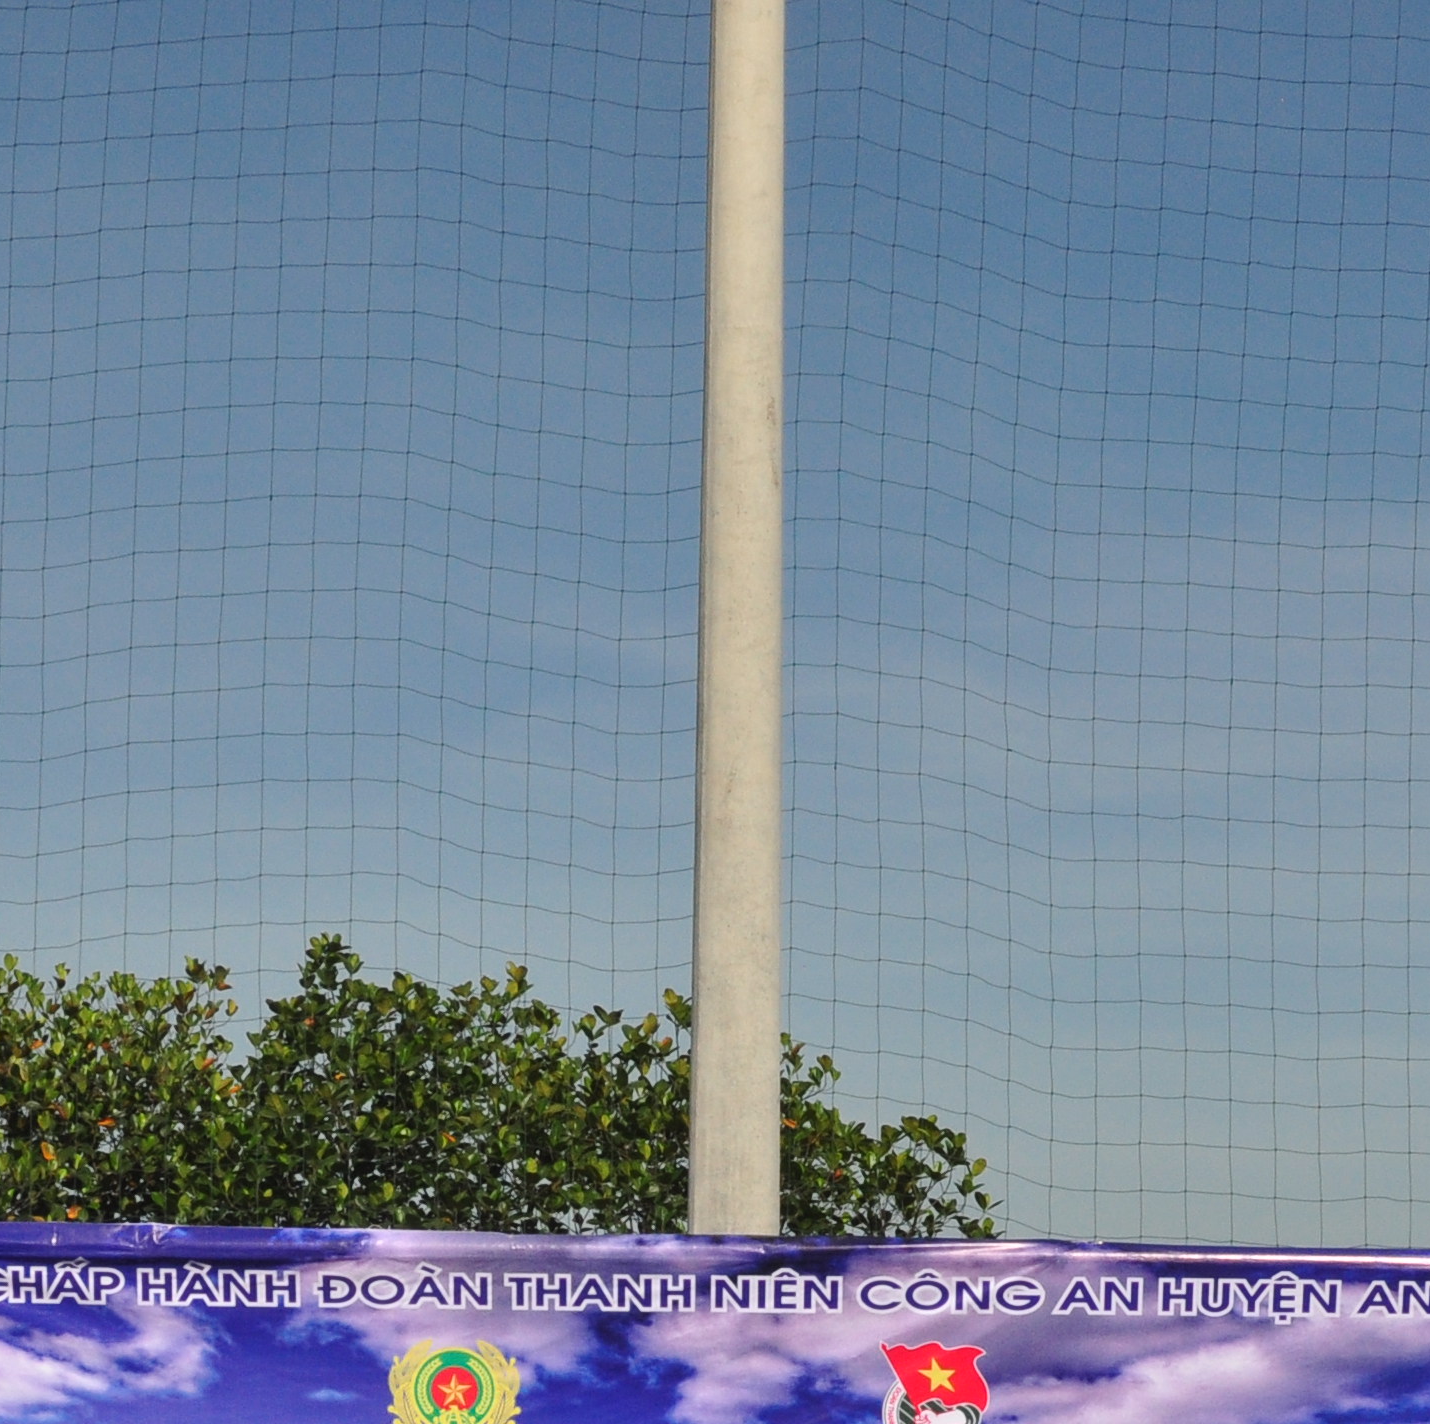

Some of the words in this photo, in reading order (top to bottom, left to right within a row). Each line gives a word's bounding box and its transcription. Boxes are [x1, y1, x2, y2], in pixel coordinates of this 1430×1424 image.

[136, 1261, 301, 1307] HÀNH
[316, 1262, 494, 1310] ĐOÀN
[504, 1272, 698, 1313] THANH
[710, 1267, 843, 1314] NIÊN
[856, 1268, 1046, 1316] CÔNG
[1051, 1276, 1143, 1316] AN
[1157, 1270, 1342, 1325] HUYỆN
